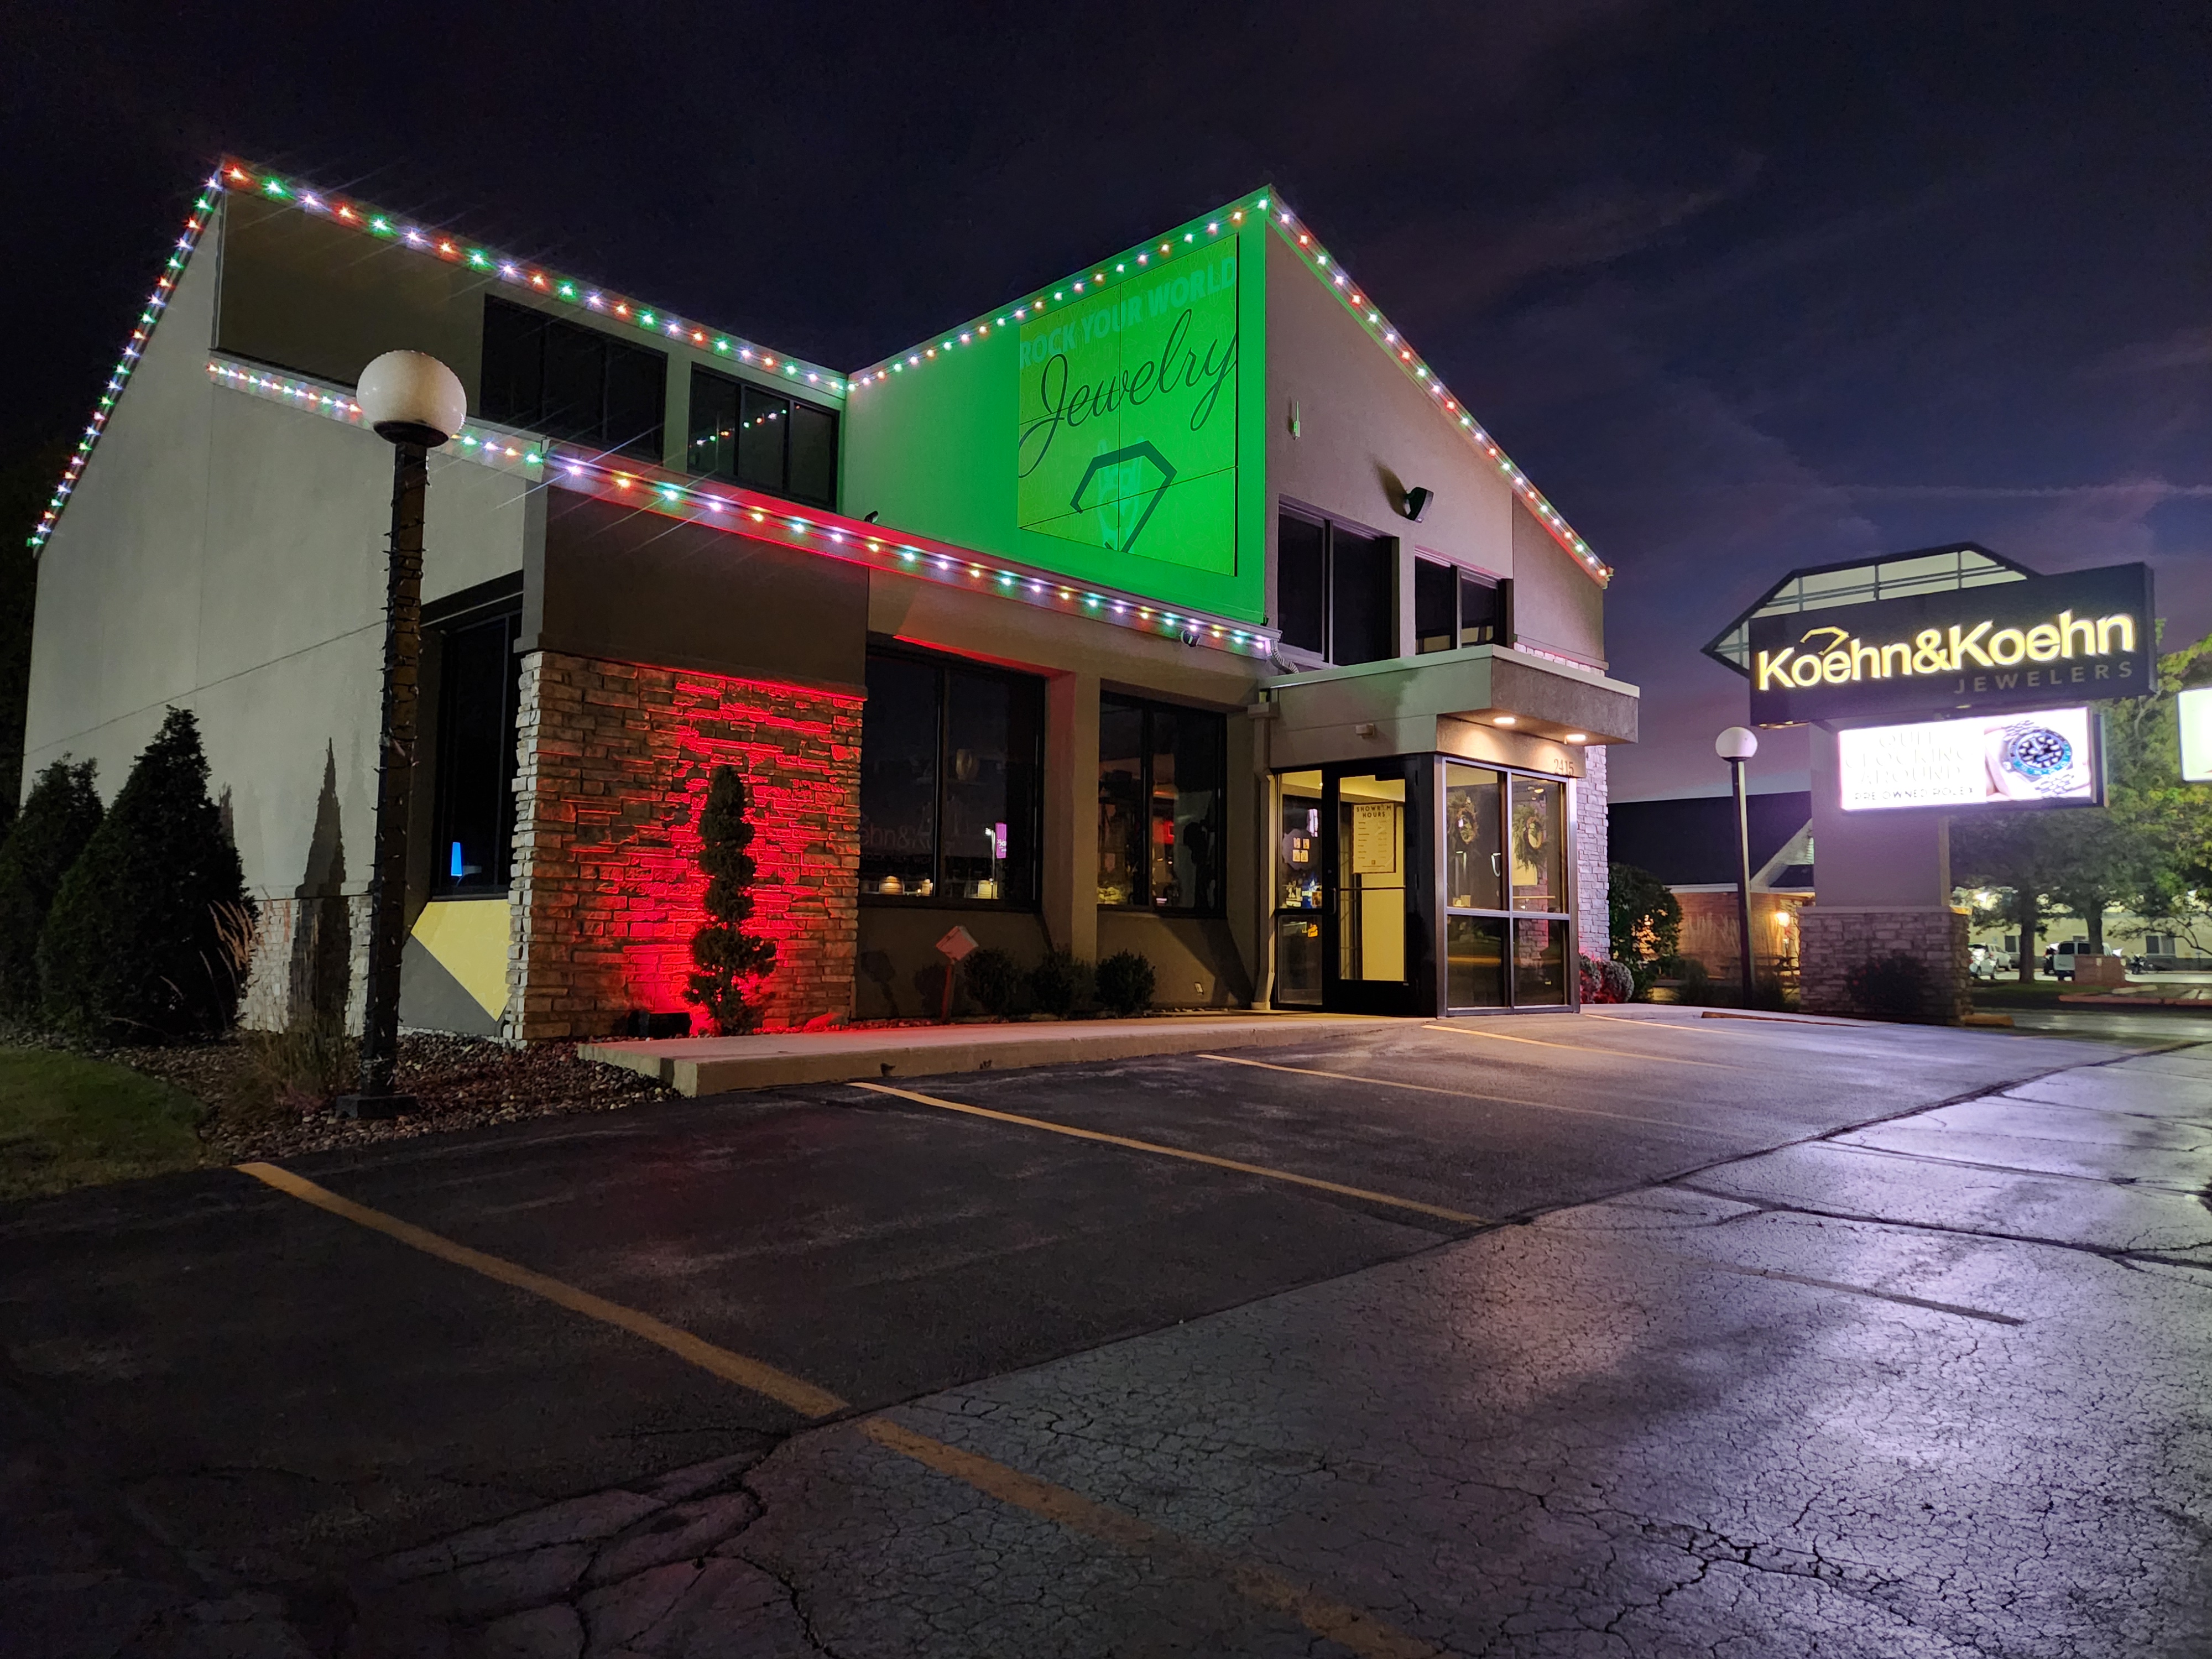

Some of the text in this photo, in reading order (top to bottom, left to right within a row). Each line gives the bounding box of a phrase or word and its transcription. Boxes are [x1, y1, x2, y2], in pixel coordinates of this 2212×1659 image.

[1020, 257, 1236, 369] ROCK YOUR WORLD
[1019, 308, 1237, 478] Jewelry
[1759, 609, 2136, 691] Koehn&Koehn
[1953, 661, 2133, 694] JEWELERS
[1553, 758, 1574, 776] 2415
[1357, 804, 1391, 812] SHOWRM
